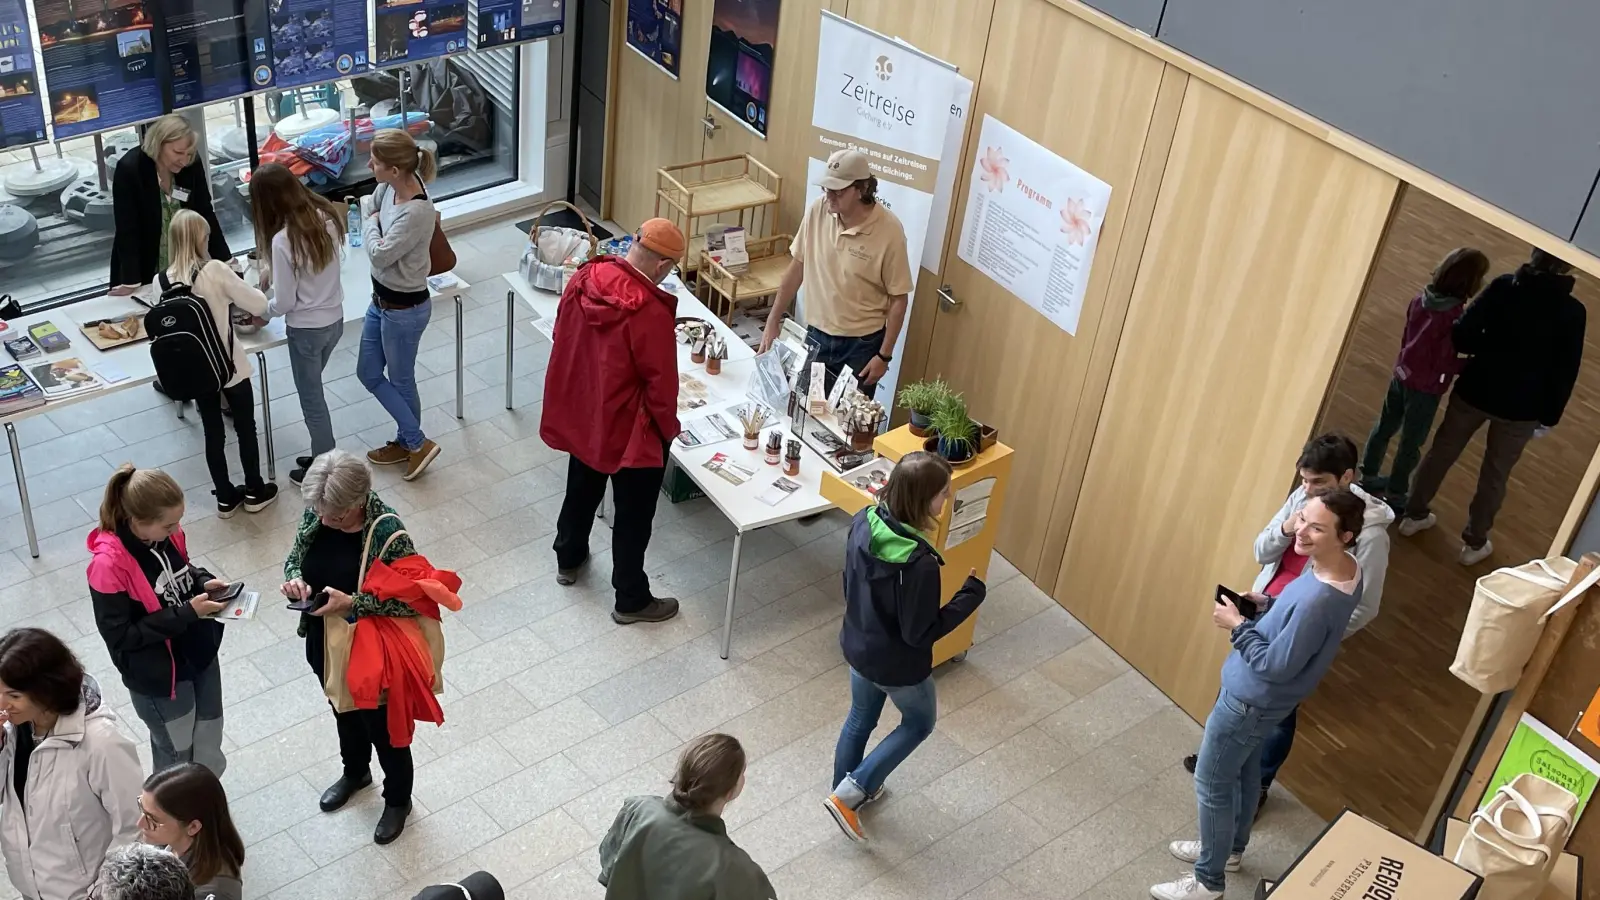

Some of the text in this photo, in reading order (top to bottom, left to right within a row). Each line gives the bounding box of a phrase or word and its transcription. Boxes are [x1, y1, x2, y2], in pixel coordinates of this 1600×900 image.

[840, 72, 915, 126] Zeitreise
[819, 135, 846, 148] Kommen
[869, 150, 882, 159] uns
[882, 153, 893, 162] auf
[894, 155, 927, 171] Zeitreisen
[867, 162, 915, 181] chte Gilchings.
[1016, 177, 1053, 210] Programm
[1535, 756, 1577, 787] Saisonal
[1546, 771, 1571, 791] lokal
